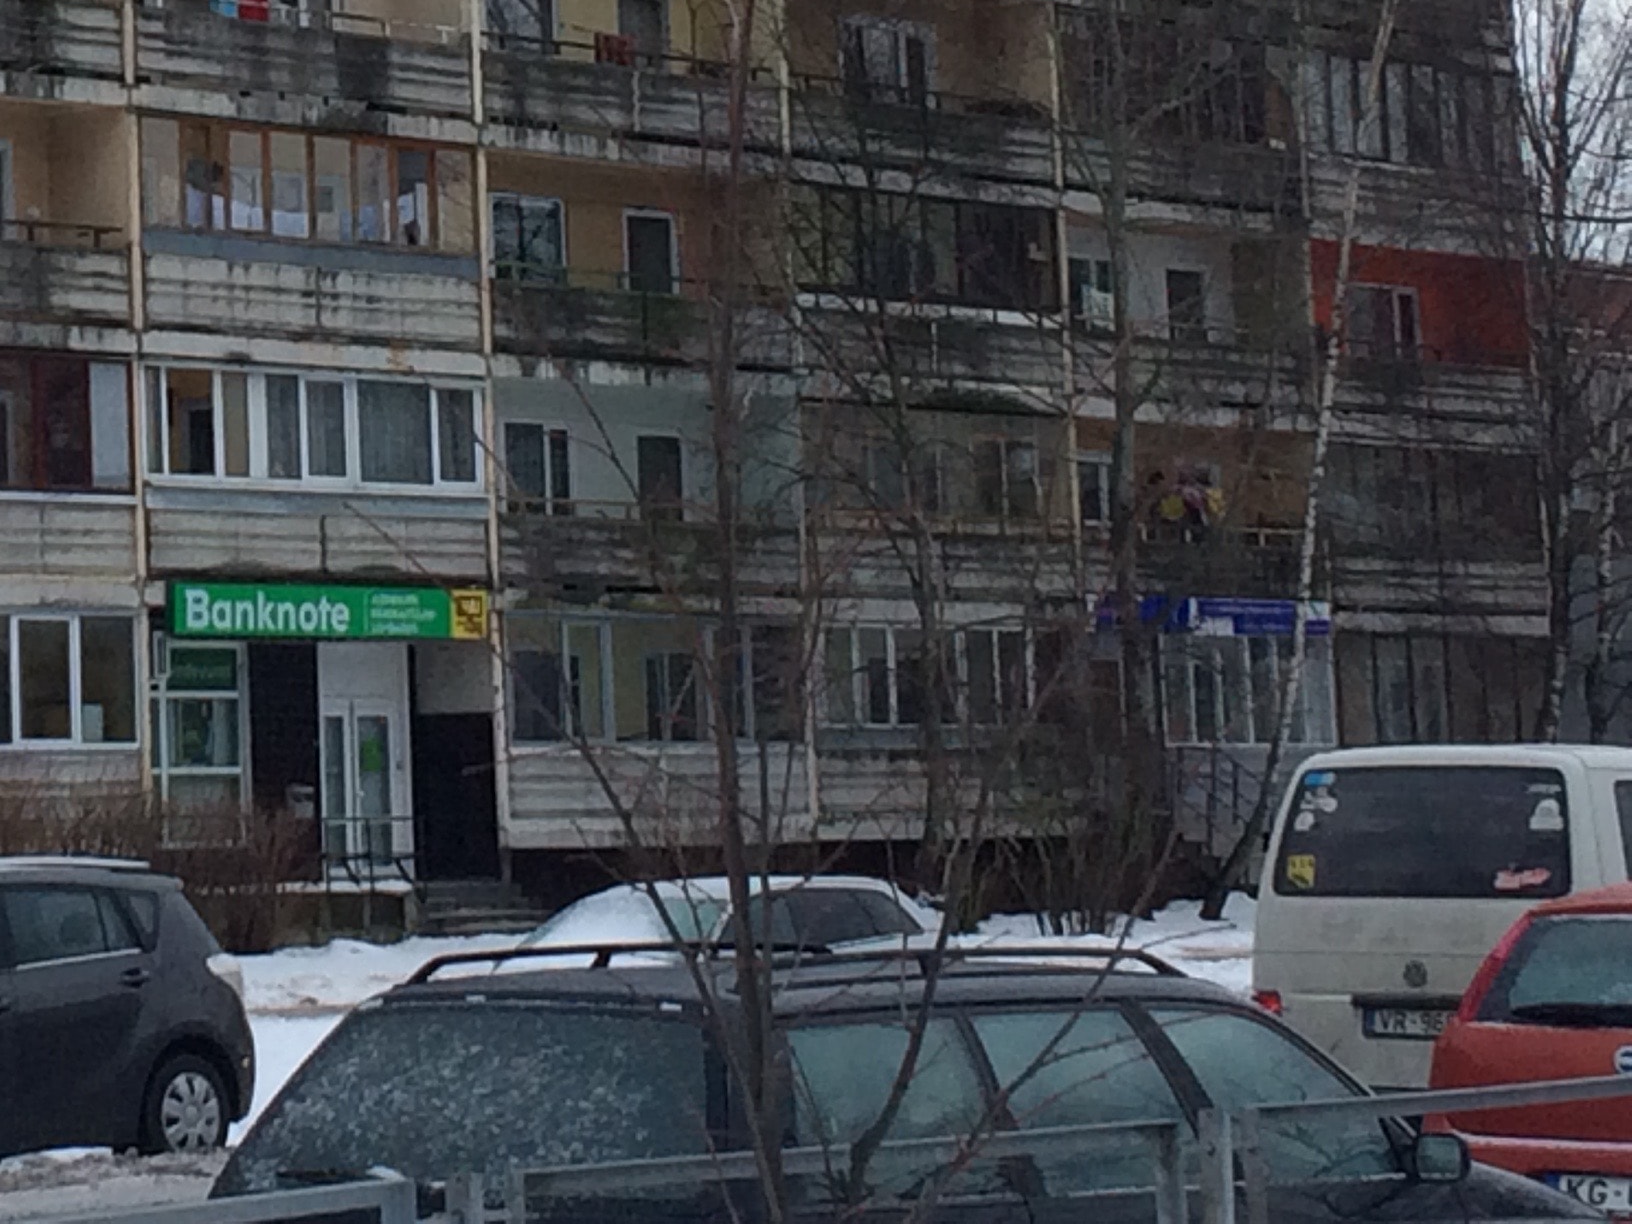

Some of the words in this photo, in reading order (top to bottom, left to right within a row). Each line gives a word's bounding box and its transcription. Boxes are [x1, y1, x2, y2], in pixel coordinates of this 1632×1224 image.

[185, 588, 351, 633] Banknote
[1377, 1010, 1455, 1033] VR-96
[1567, 1178, 1632, 1206] KG-
